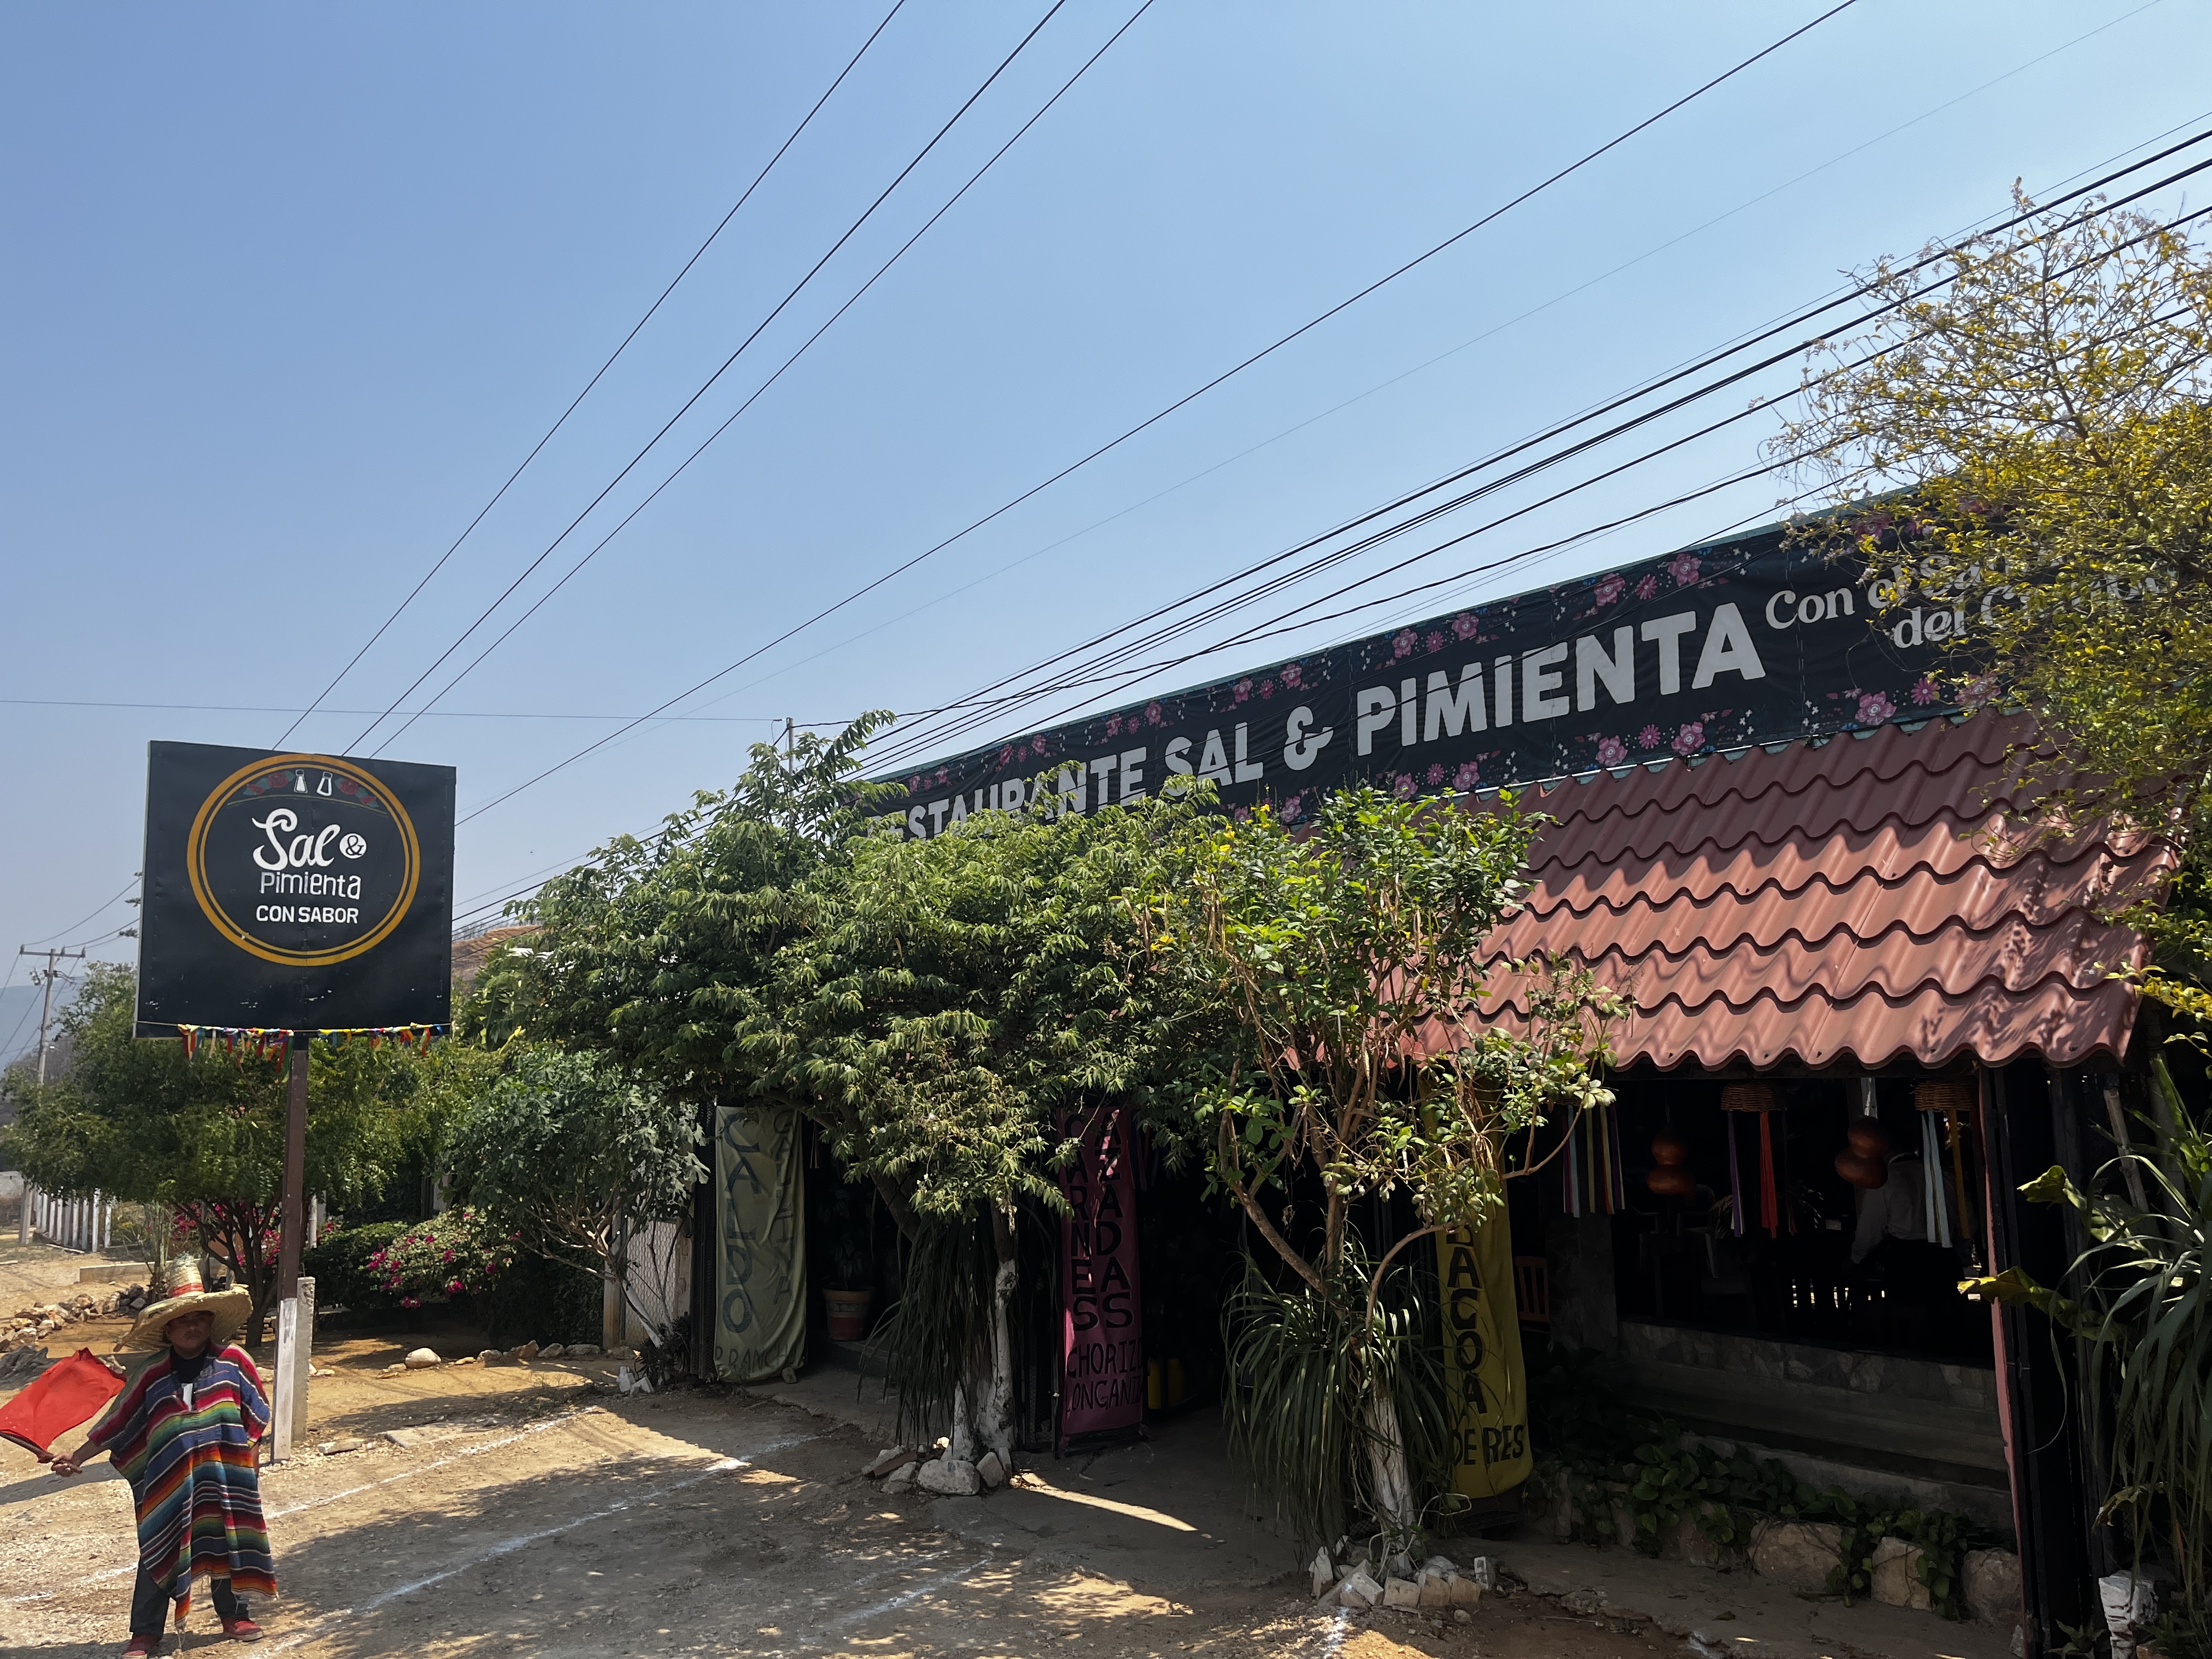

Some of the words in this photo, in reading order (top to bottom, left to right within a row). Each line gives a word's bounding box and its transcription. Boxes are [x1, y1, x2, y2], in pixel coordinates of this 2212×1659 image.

[1765, 586, 1855, 630] Con
[1164, 721, 1264, 797] SAL
[1283, 706, 1334, 771] &
[1356, 602, 1765, 757] PIMIENTA
[251, 808, 341, 871] Sal
[342, 833, 365, 857] &
[259, 871, 362, 900] Pimienta
[256, 905, 295, 923] CON
[298, 906, 359, 924] SABOR
[721, 1112, 761, 1334] CALDO
[1064, 1114, 1098, 1332] CARNES
[1452, 1428, 1476, 1466] DE
[1483, 1424, 1524, 1464] RES
